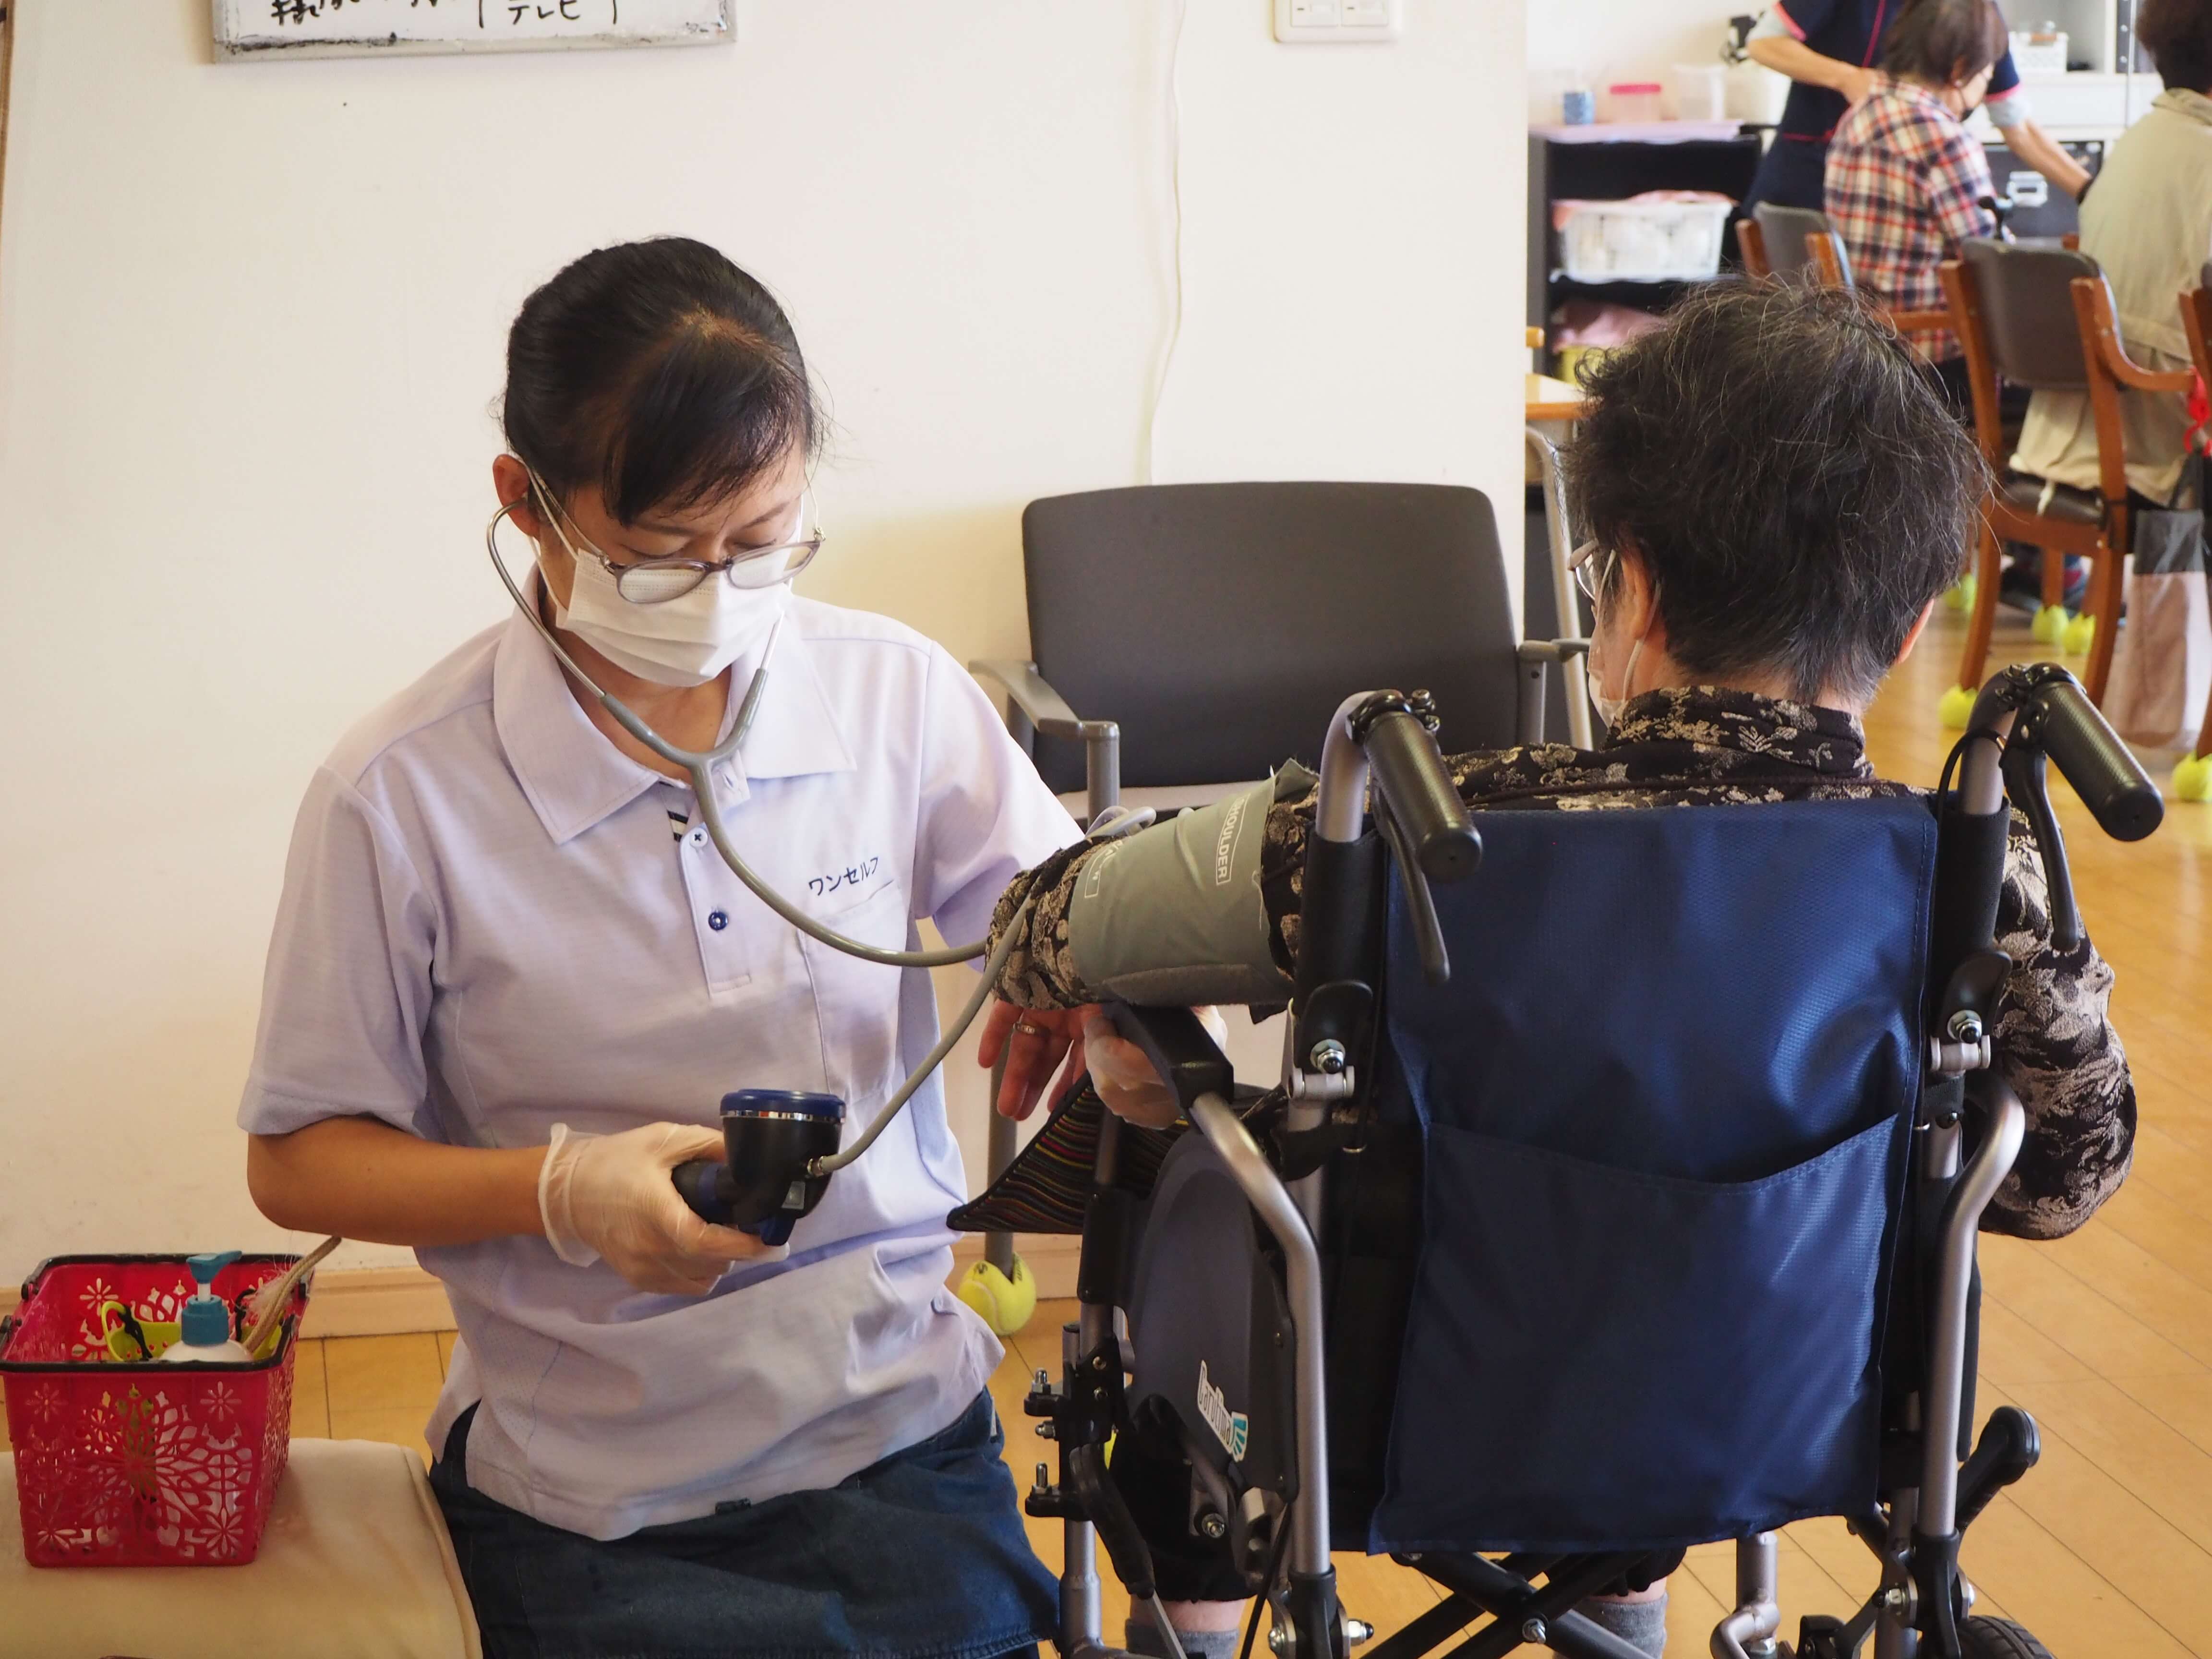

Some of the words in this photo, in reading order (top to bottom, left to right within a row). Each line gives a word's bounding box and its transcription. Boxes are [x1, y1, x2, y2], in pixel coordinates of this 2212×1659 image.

[808, 856, 879, 896] ワンセルフ
[1199, 1365, 1232, 1445] Carutima
